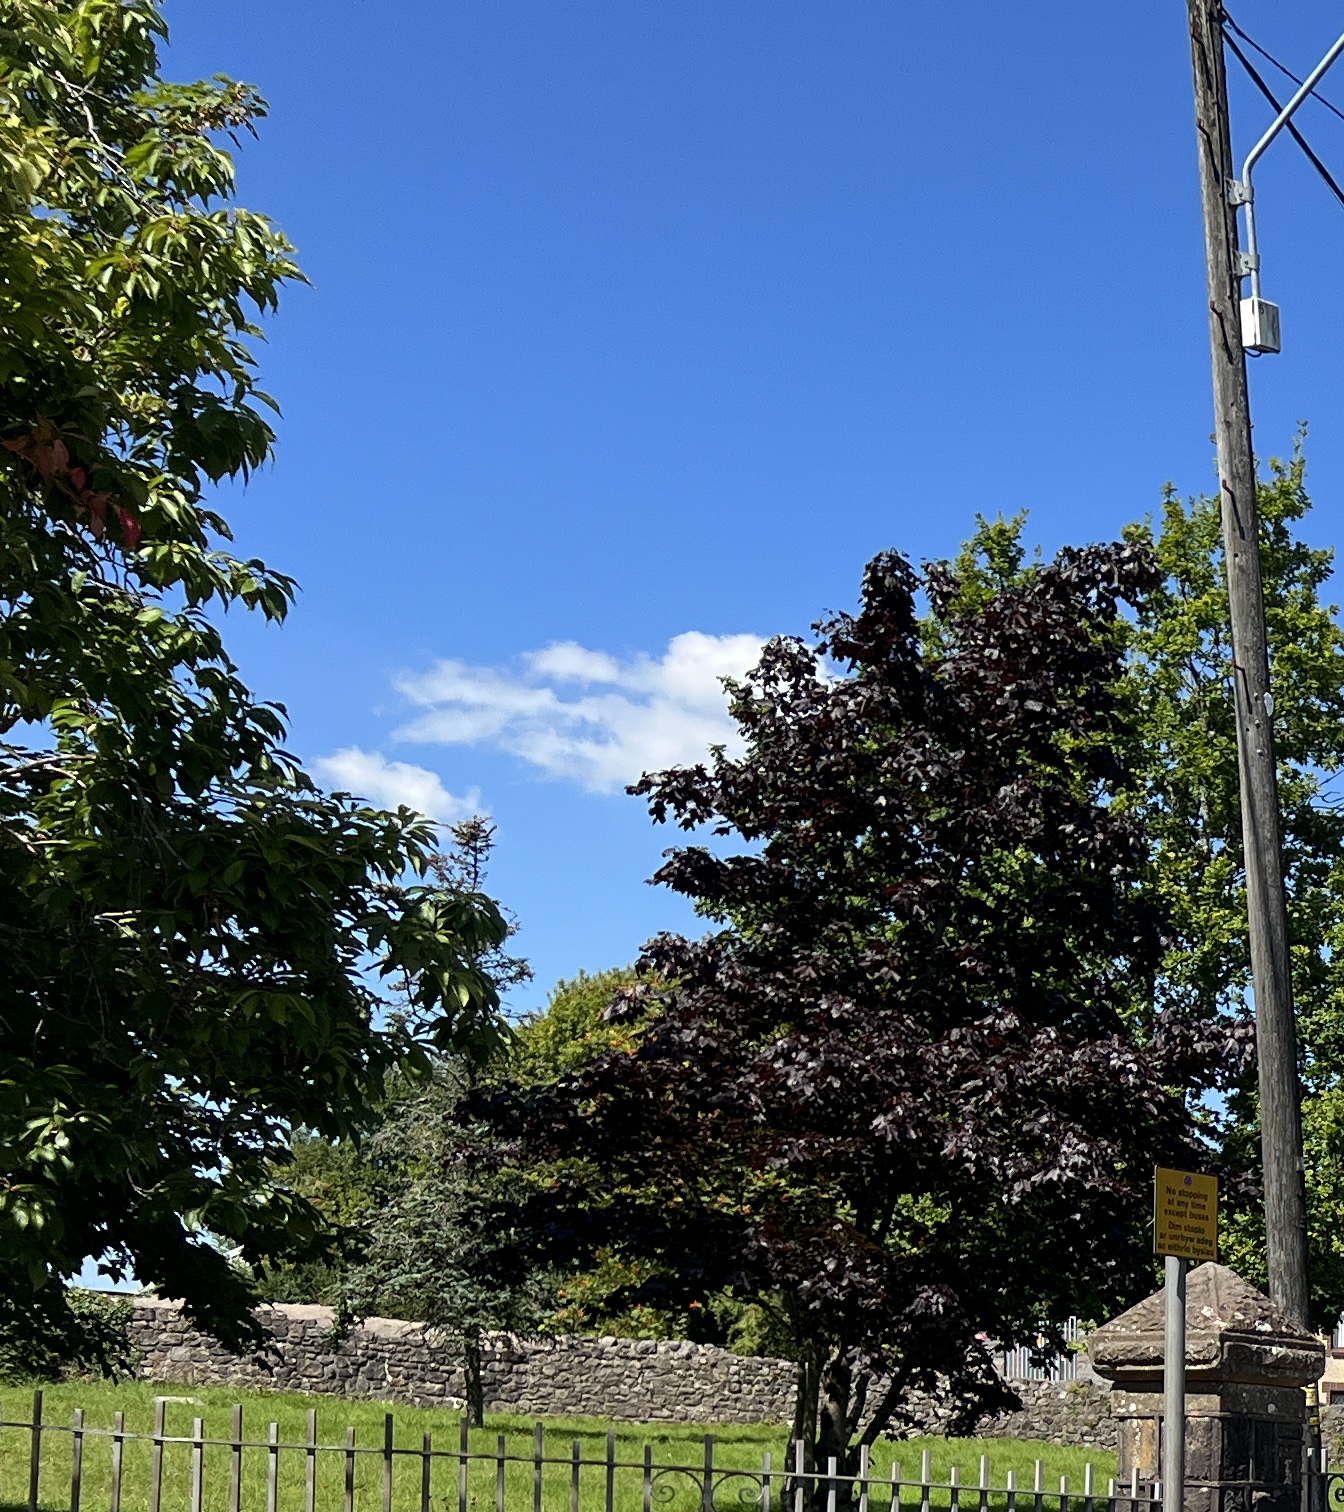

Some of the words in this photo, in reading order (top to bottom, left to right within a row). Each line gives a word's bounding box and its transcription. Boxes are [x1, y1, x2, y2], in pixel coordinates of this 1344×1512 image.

[1166, 1186, 1176, 1196] No
[1178, 1188, 1208, 1202] stopping
[1177, 1200, 1189, 1209] any
[1191, 1201, 1206, 1210] time
[1164, 1209, 1187, 1218] except
[1189, 1211, 1210, 1221] buses
[1168, 1221, 1182, 1231] Dim
[1184, 1224, 1205, 1235] stopio
[1168, 1233, 1195, 1244] unrhyw
[1196, 1237, 1213, 1247] adeg
[1158, 1242, 1166, 1250] ac
[1168, 1243, 1191, 1253] eithrio
